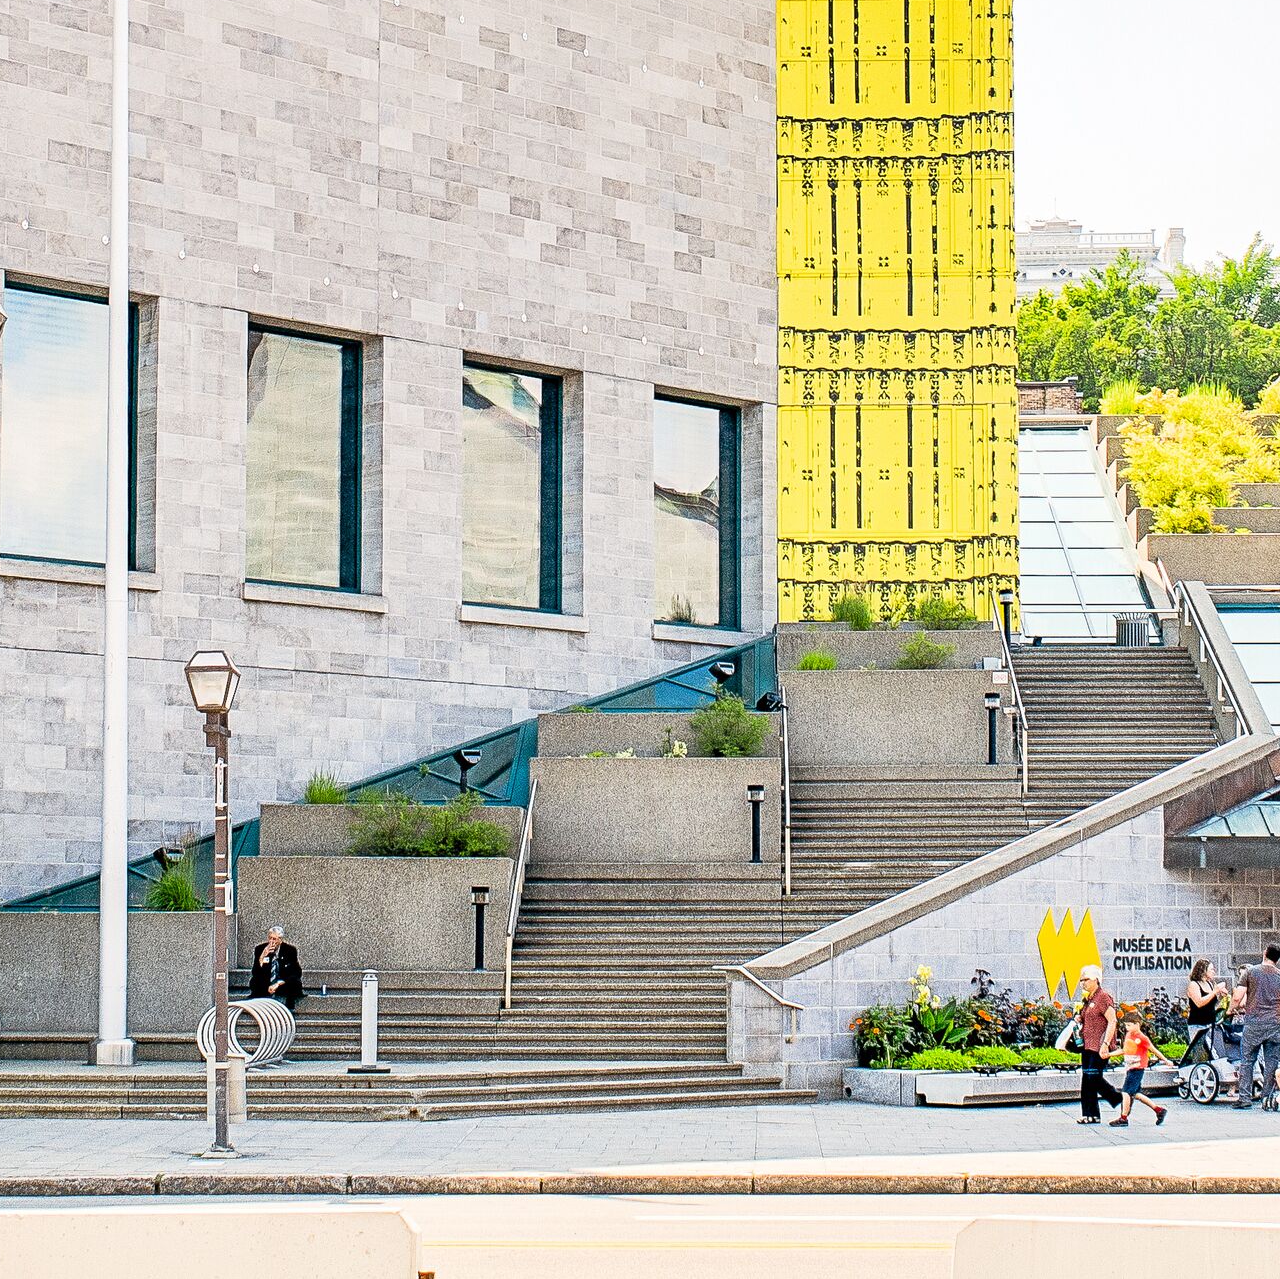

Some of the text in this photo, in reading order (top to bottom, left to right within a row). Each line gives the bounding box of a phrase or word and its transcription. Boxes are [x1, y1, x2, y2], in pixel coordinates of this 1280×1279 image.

[1113, 934, 1192, 952] MUSÉE DE LA
[1113, 956, 1192, 971] CIVILISATION
